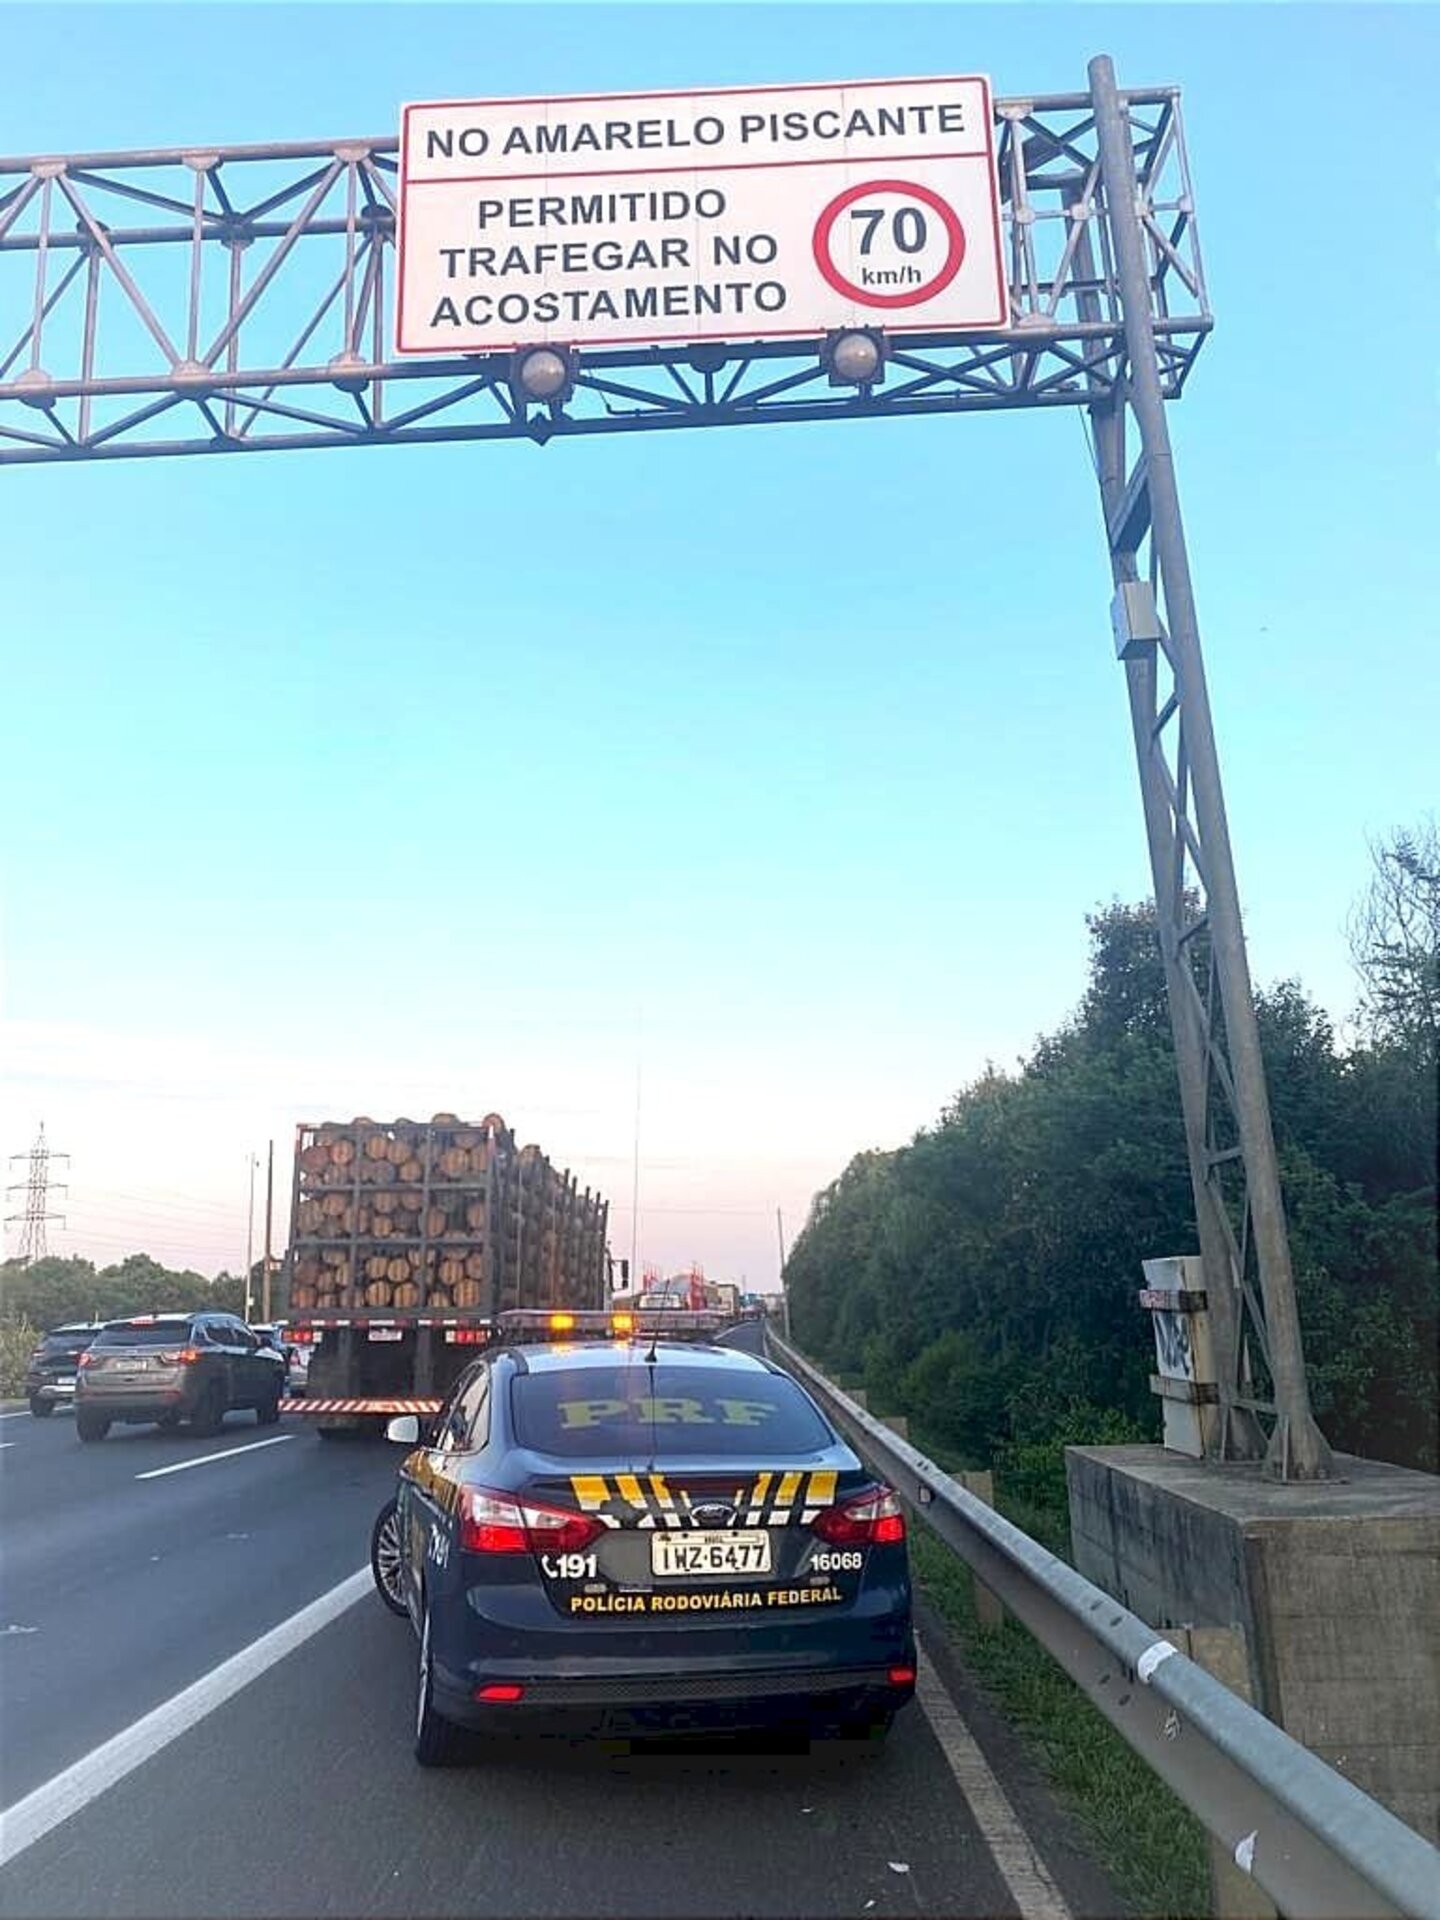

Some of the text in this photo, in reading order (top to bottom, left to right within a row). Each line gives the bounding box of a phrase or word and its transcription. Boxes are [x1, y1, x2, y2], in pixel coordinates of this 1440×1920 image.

[426, 103, 966, 159] NO AMARELO PISCANTE
[478, 189, 726, 230] PERMITIDO
[850, 207, 928, 256] 70
[440, 234, 778, 278] TRAFEGAR NO
[861, 264, 922, 287] km/h
[429, 280, 788, 328] ACOSTAMENTO
[556, 1397, 780, 1432] PRF
[556, 1553, 597, 1578] 191
[810, 1553, 862, 1573] 16068
[571, 1587, 842, 1612] POLÍCIA RODOVIÁRIA FEDERAL
